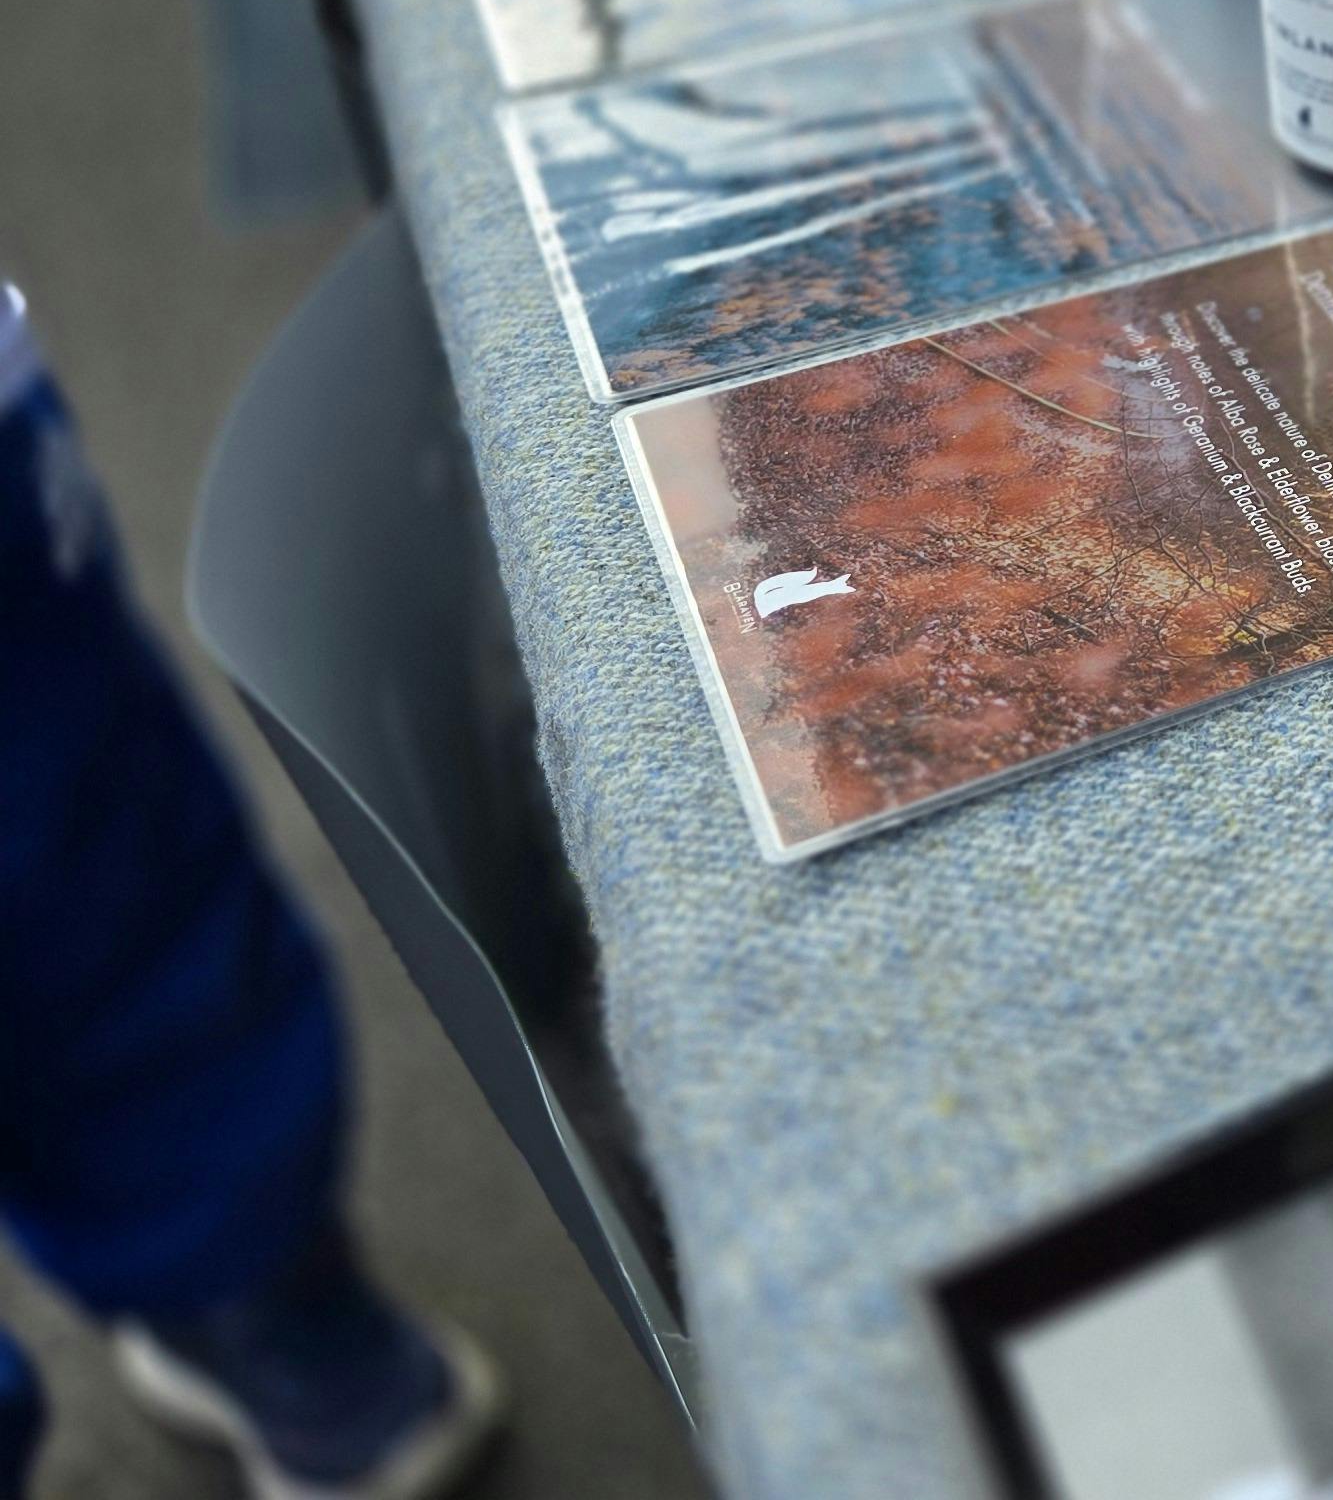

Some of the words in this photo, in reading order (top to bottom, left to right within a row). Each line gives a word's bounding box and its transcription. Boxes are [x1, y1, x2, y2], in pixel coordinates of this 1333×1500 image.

[1138, 347, 1180, 401] highlights
[1189, 352, 1215, 384] notes
[1196, 301, 1237, 347] Discover
[1229, 346, 1249, 368] the
[1243, 365, 1280, 411] delicate
[1274, 409, 1307, 448] nature
[1302, 446, 1327, 464] of
[1208, 384, 1233, 400] of
[1173, 400, 1198, 417] of
[1217, 396, 1244, 428] Alba
[1184, 416, 1231, 474] Geranium
[1238, 427, 1265, 456] Rose
[1221, 471, 1243, 486] &
[1259, 456, 1279, 470] &
[1267, 467, 1324, 537] Elderflower
[1230, 482, 1290, 562] Blackcurrant
[1281, 558, 1316, 597] Buds.
